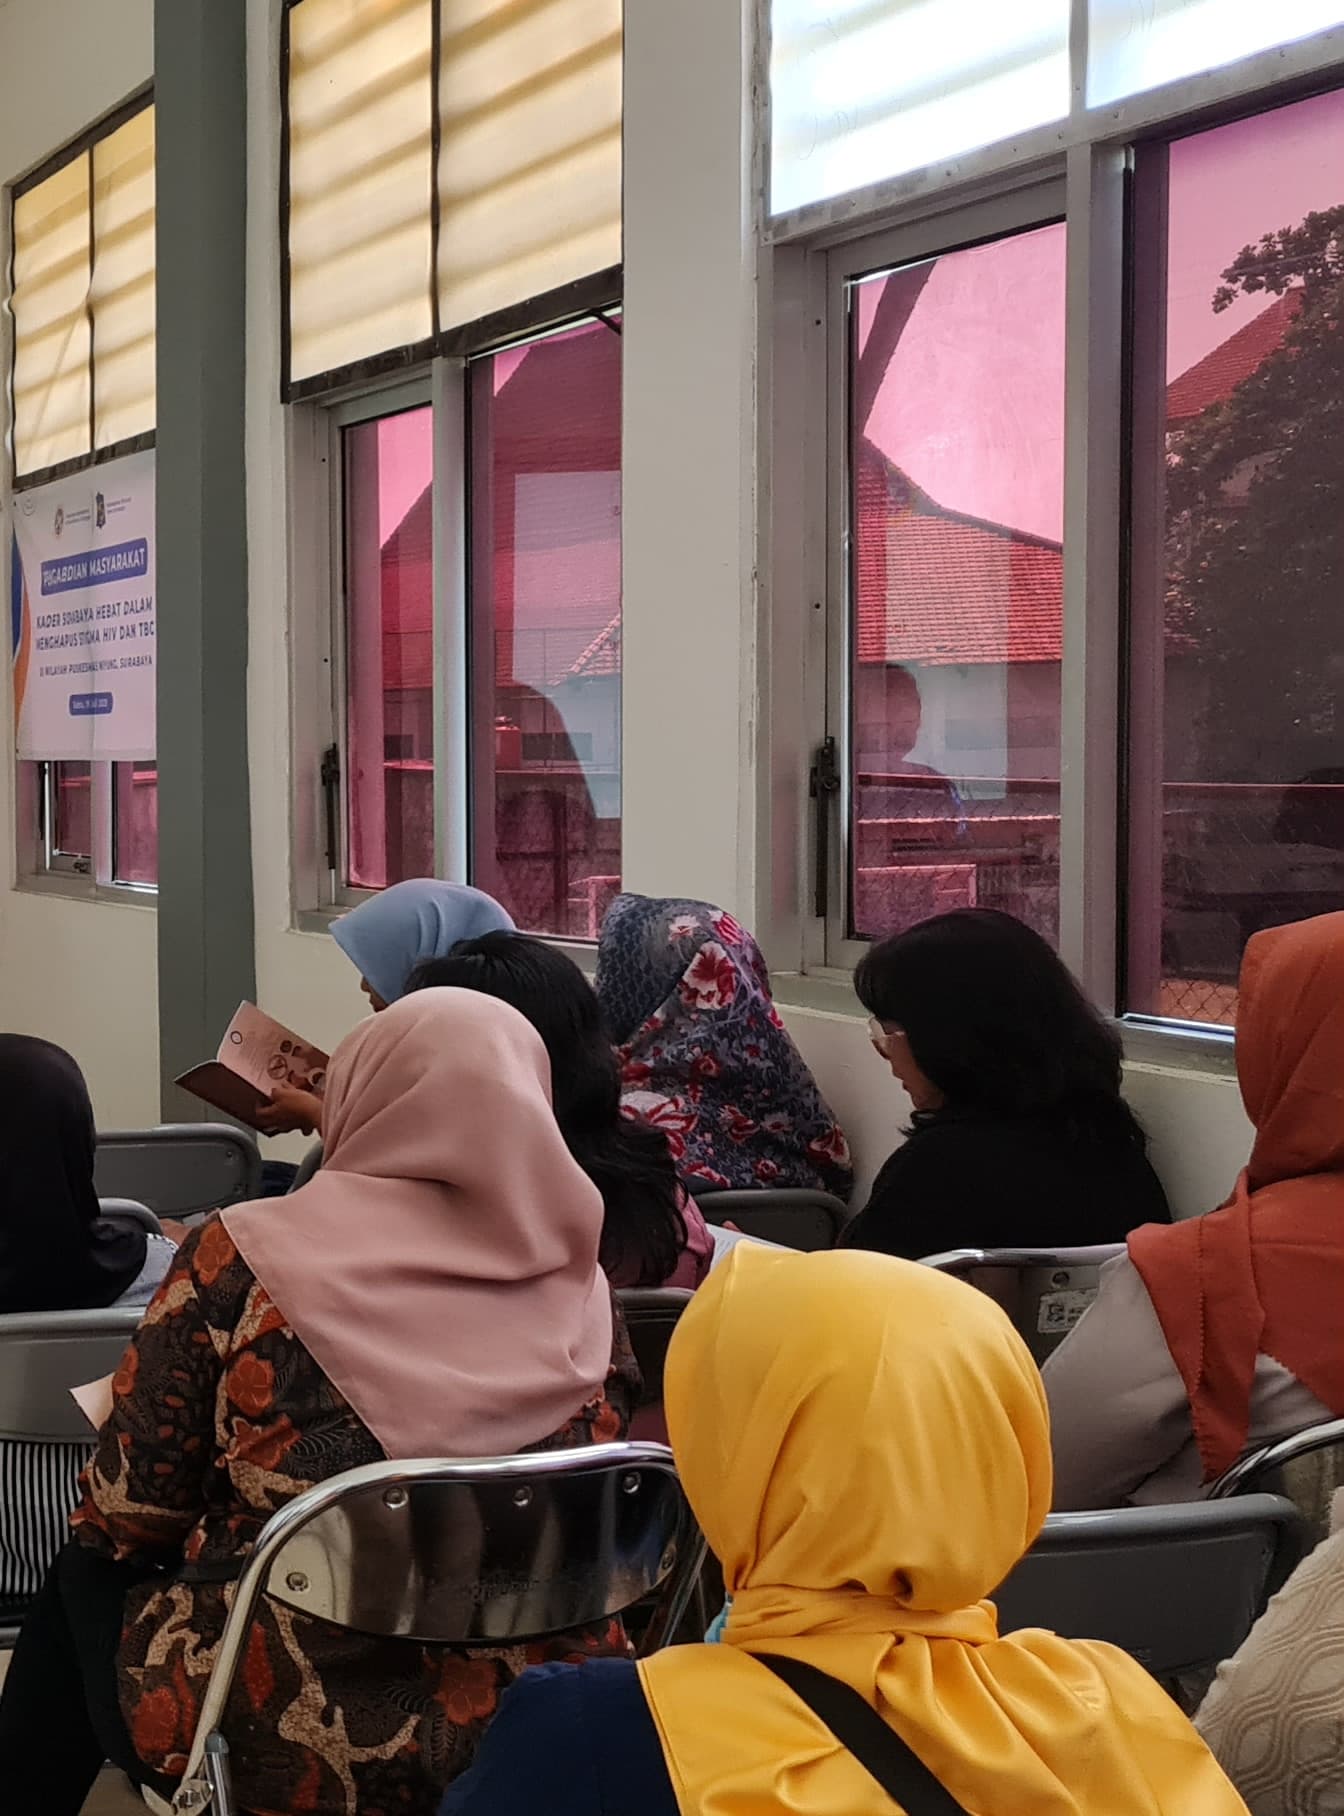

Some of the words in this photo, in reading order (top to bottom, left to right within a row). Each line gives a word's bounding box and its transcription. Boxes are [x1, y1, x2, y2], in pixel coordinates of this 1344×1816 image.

[89, 547, 146, 577] MASYARAKAT
[37, 613, 61, 629] KADER
[95, 602, 121, 620] HEBAT
[123, 596, 153, 616] DALAM
[102, 625, 118, 642] HIV
[119, 623, 136, 640] DAN
[139, 620, 154, 637] TBC
